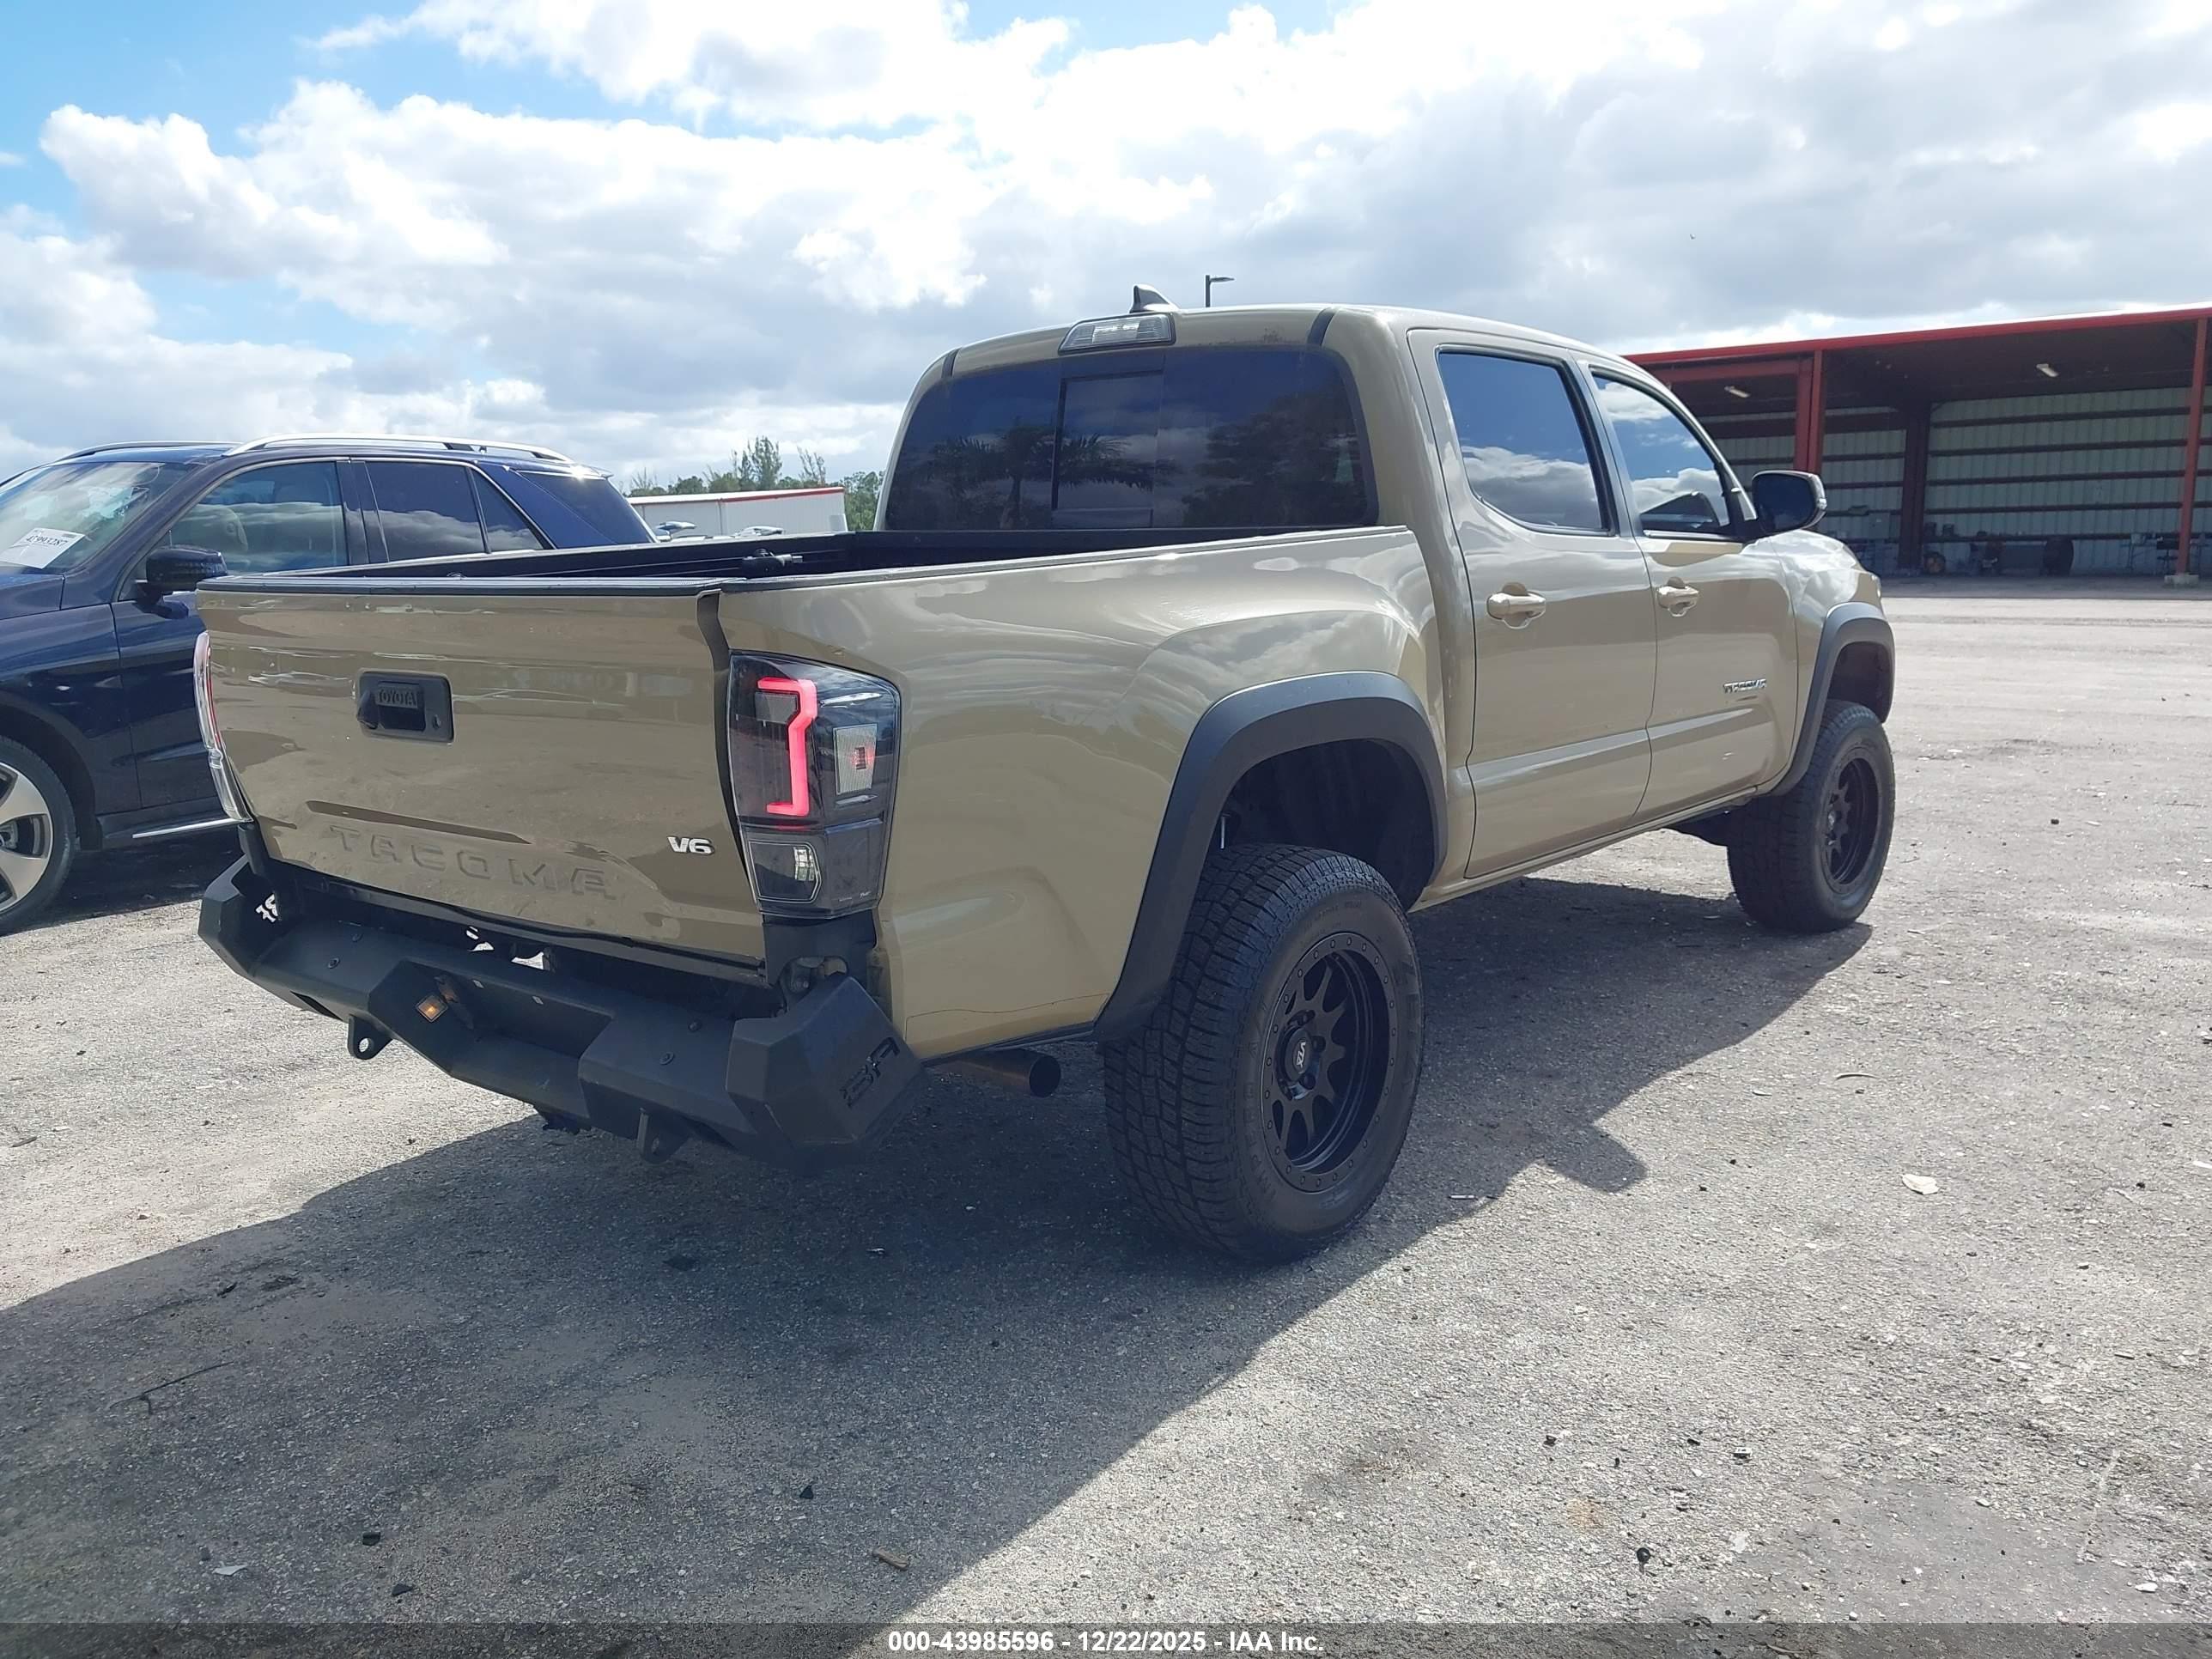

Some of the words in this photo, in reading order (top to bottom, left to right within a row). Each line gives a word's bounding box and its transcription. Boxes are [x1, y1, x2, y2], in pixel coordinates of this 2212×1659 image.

[379, 689, 417, 706] TOYOTA
[666, 836, 715, 855] V6
[330, 824, 617, 901] TACOMA
